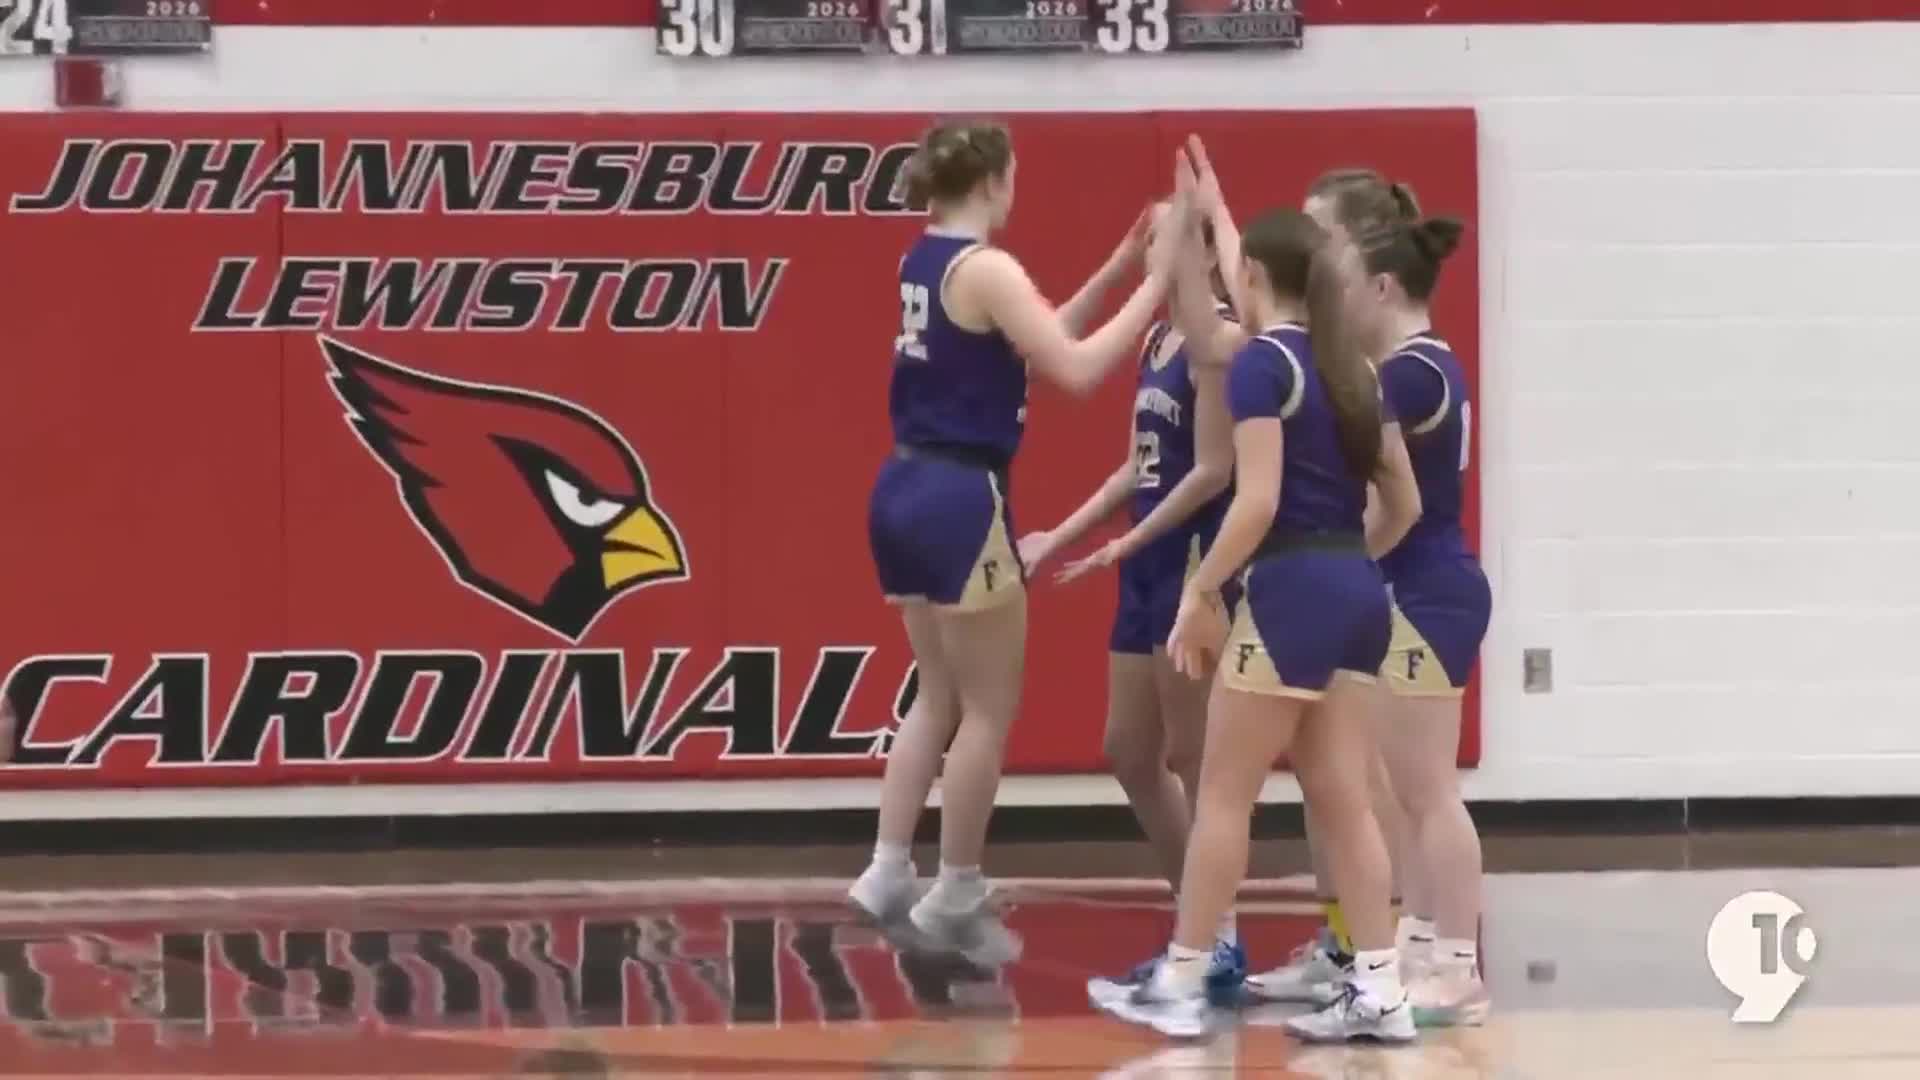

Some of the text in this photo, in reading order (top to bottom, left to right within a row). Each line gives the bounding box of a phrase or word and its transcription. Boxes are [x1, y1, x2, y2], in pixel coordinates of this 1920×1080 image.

[147, 1, 200, 16] 2026
[807, 2, 859, 16] 2026
[1026, 1, 1077, 18] 2026
[0, 0, 73, 54] 24
[661, 0, 734, 56] 30
[1097, 0, 1169, 52] 33
[190, 256, 789, 332] LEWISTON
[984, 560, 998, 592] F
[1238, 643, 1255, 674] F
[1407, 649, 1425, 680] F
[0, 646, 918, 769] CARDINAL
